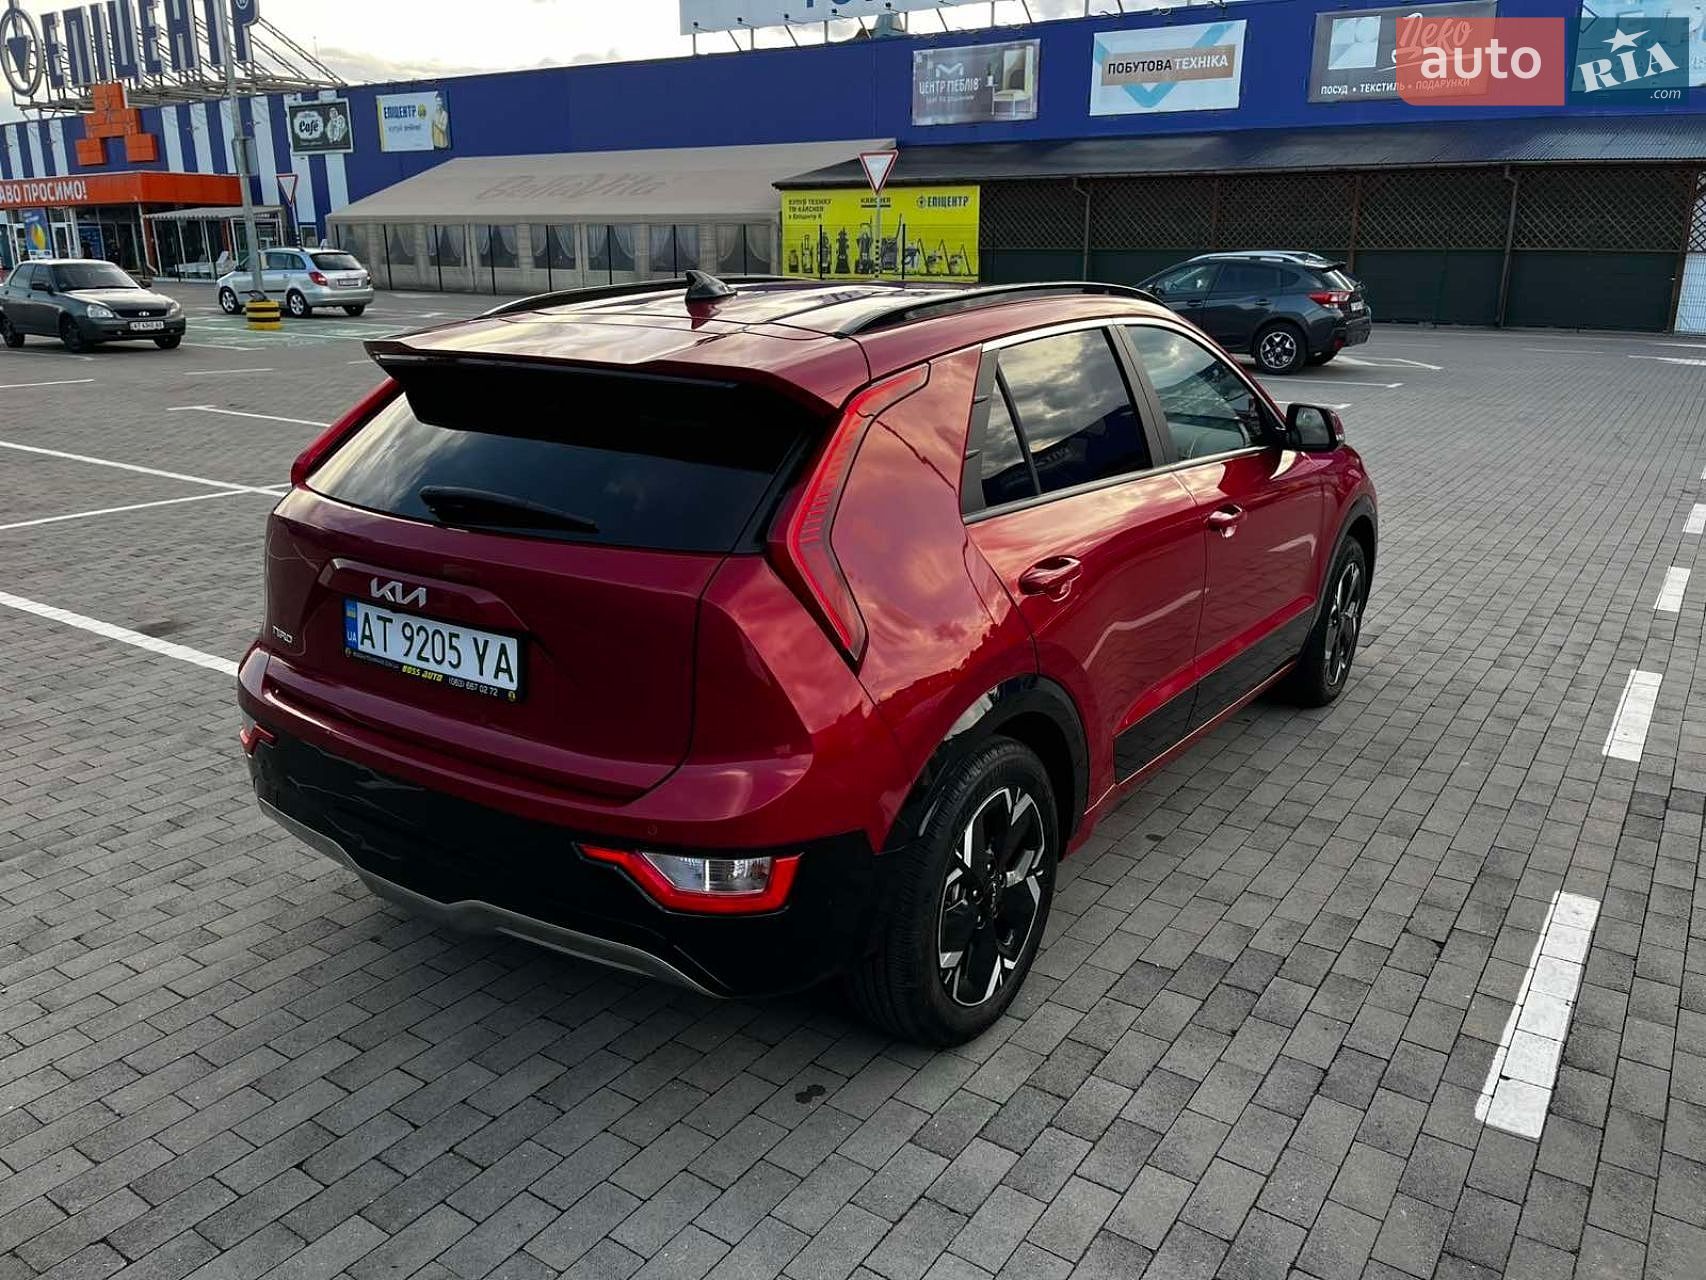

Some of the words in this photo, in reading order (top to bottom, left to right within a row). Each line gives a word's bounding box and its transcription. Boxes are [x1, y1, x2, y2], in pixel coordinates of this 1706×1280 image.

[1108, 59, 1172, 75] ПОБУТОВА
[1175, 54, 1229, 70] ТЕХНІКА
[919, 80, 945, 95] ЦЕНТР
[1320, 85, 1348, 94] ПОСУД
[1360, 81, 1405, 93] ТЕКСТИЛЬ
[1416, 79, 1471, 90] ПОДАРУНКИ
[299, 119, 320, 136] Café
[22, 180, 88, 203] ПРОСИМО!
[927, 196, 969, 208] ЕПІЦЕНТР
[346, 632, 357, 642] UA
[360, 612, 394, 653] AT
[401, 621, 462, 670] 9205
[472, 636, 514, 683] YA
